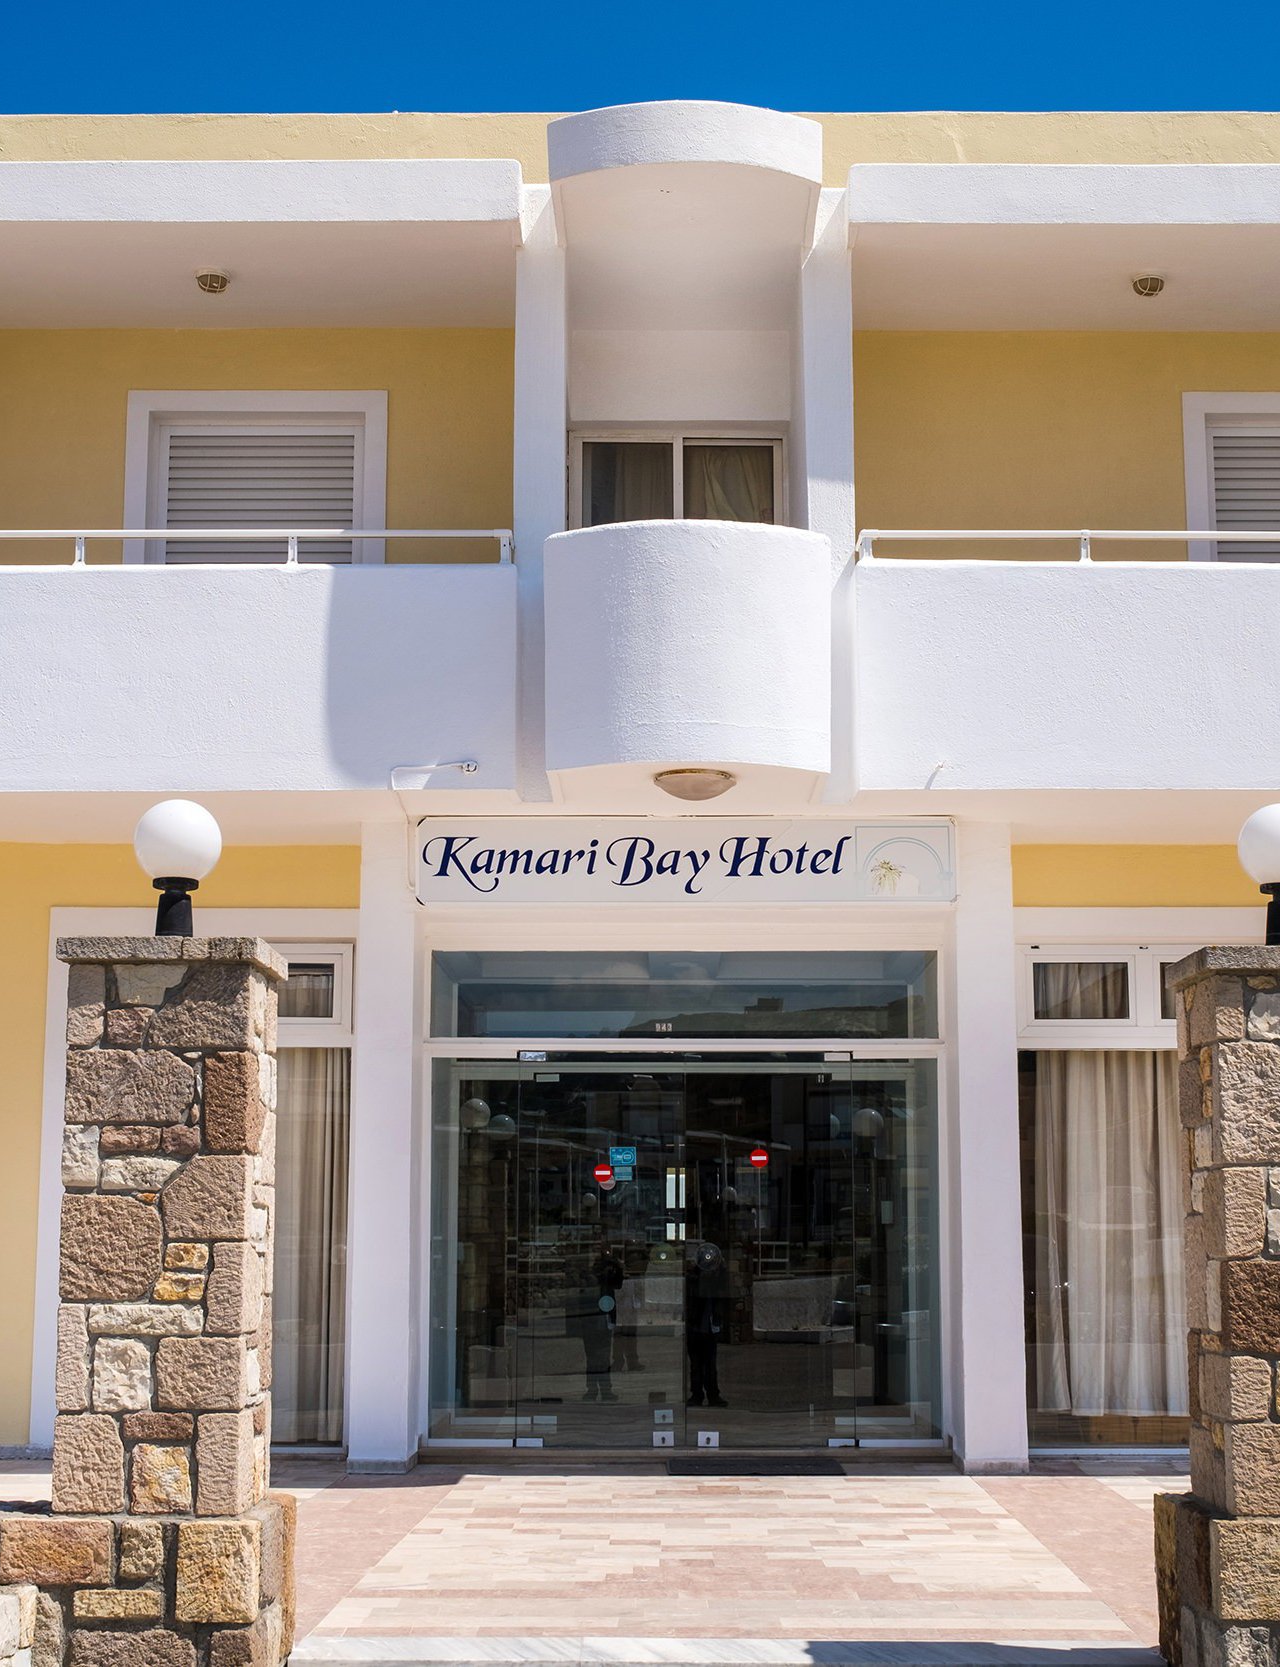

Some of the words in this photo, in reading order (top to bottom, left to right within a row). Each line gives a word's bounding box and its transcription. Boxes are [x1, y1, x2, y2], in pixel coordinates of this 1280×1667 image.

[422, 836, 599, 893] Kamari
[605, 836, 711, 895] Bay
[719, 835, 852, 877] Hotel
